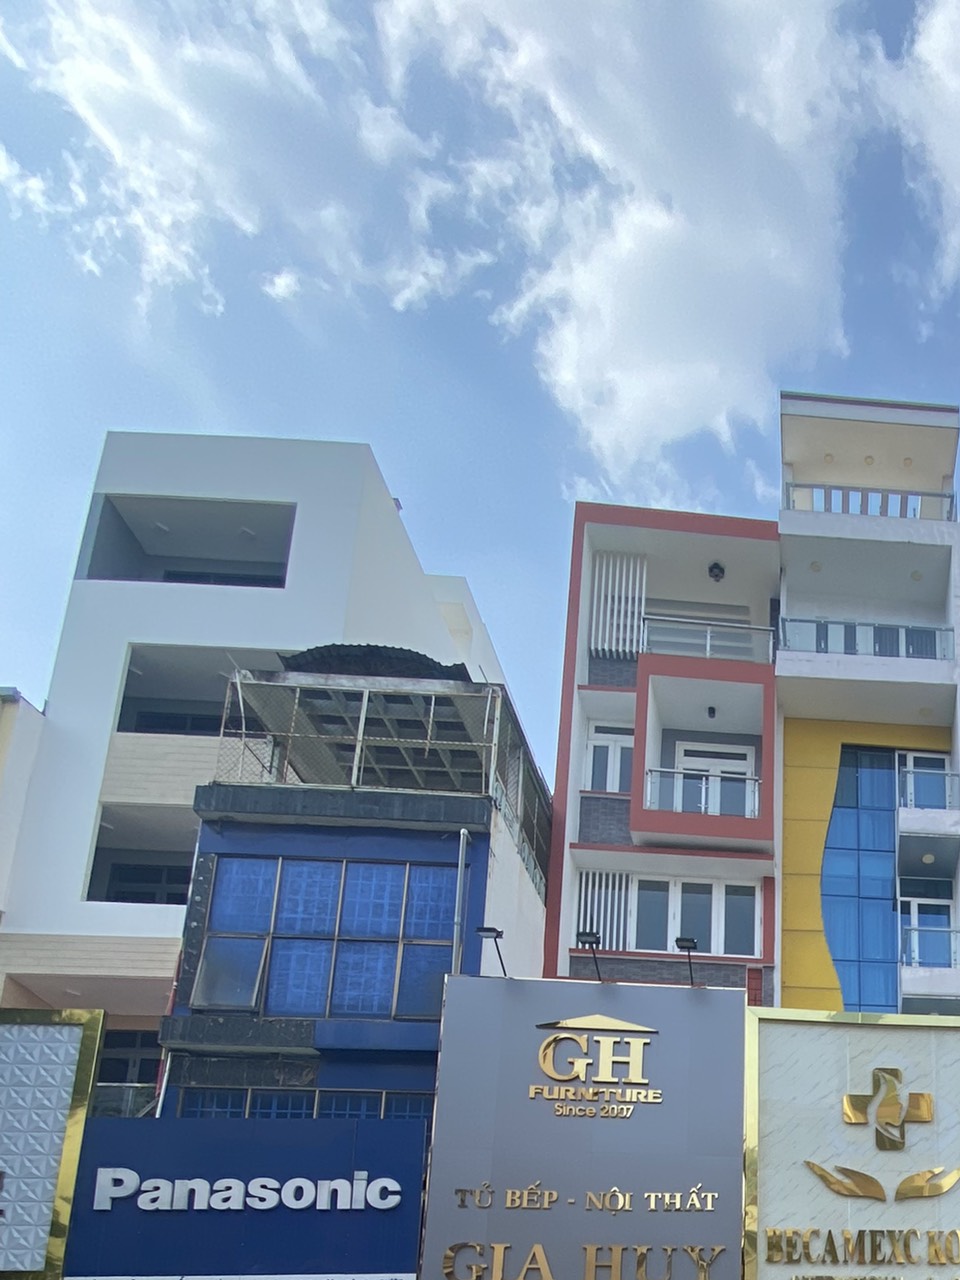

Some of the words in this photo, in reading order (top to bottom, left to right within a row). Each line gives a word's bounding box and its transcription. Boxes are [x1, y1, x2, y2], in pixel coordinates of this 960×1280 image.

[538, 1032, 651, 1085] GH
[528, 1085, 664, 1104] FURNITURE
[554, 1103, 597, 1117] Since
[599, 1104, 635, 1119] 2007
[93, 1167, 402, 1212] Panasonic
[455, 1181, 495, 1210] TỦ
[504, 1180, 560, 1211] BẾP
[584, 1187, 634, 1216] NỘI
[644, 1182, 719, 1212] THẤT
